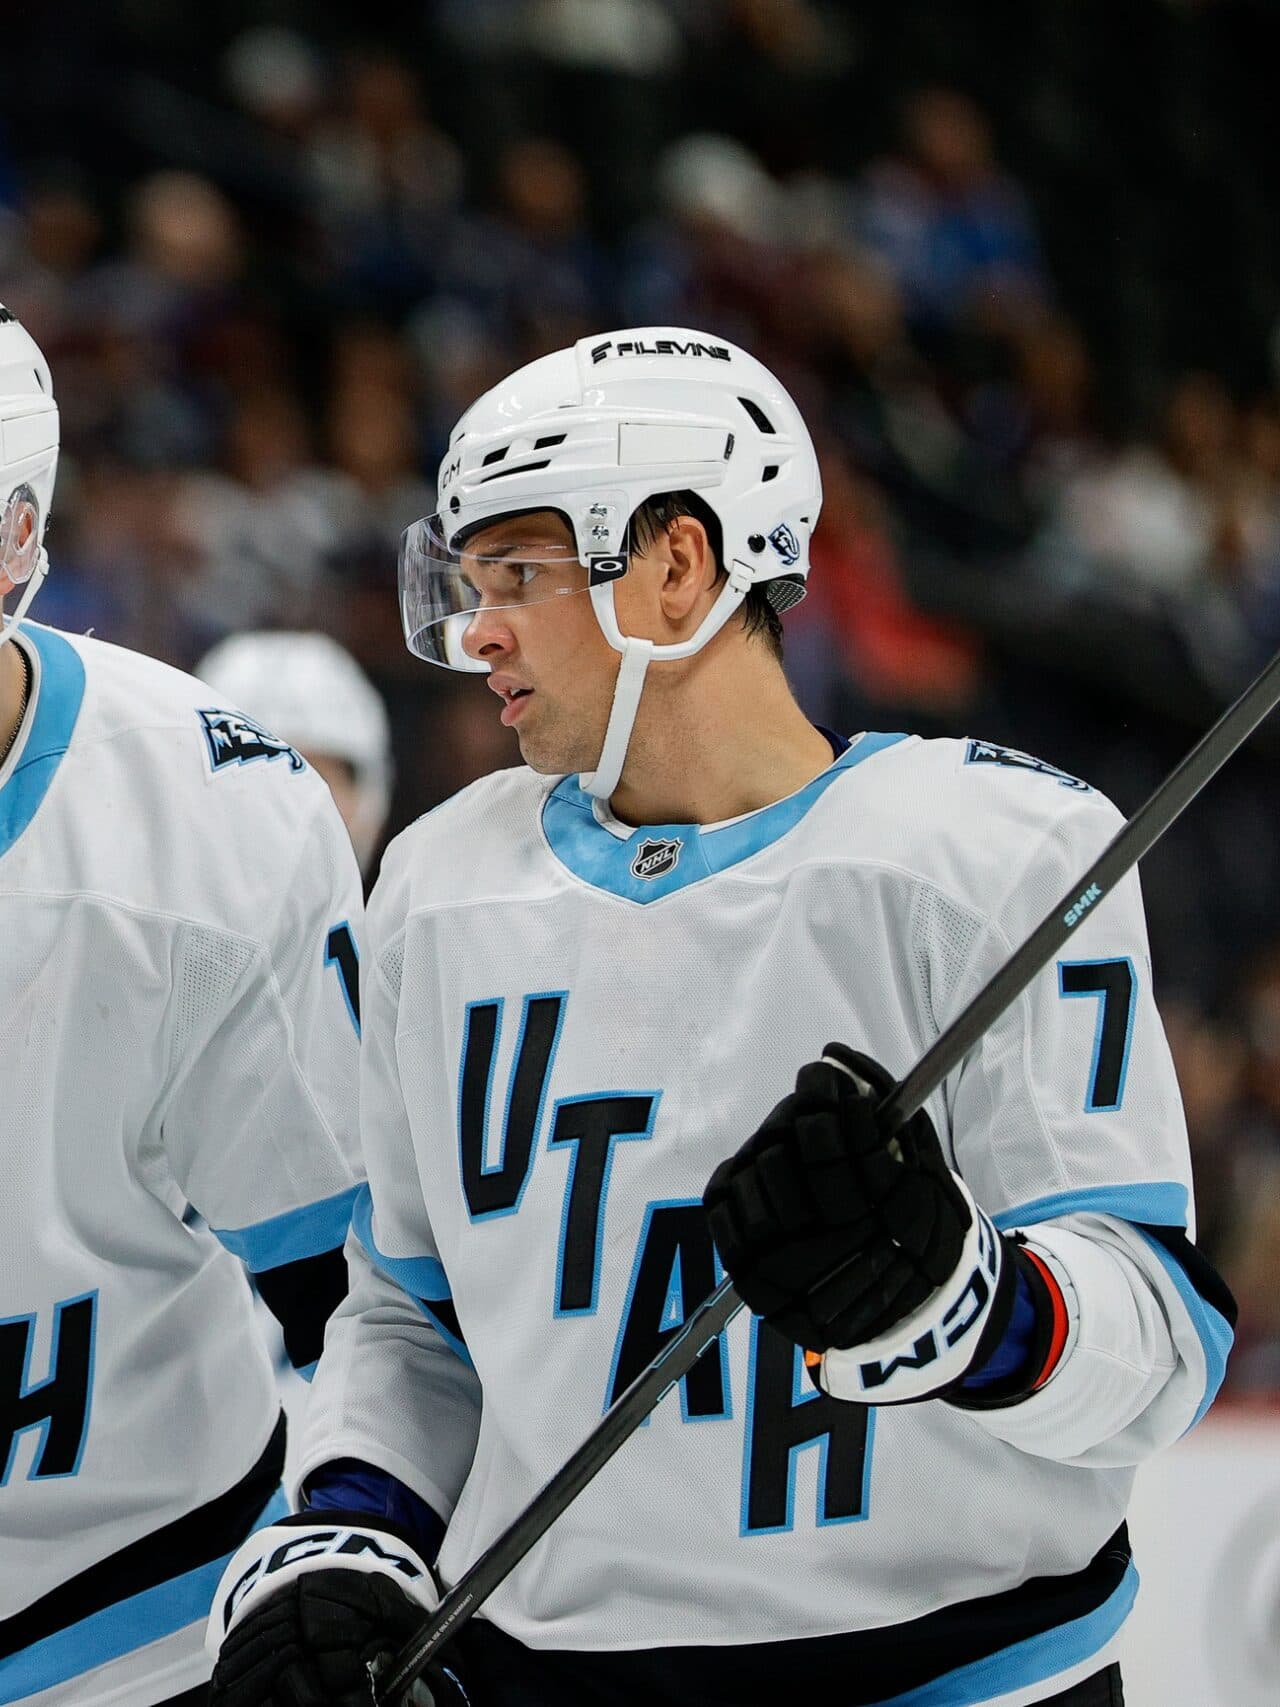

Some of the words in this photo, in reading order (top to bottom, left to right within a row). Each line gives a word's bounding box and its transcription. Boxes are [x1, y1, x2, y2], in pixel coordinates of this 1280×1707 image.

[617, 341, 731, 362] FILEVINE
[442, 457, 461, 489] CM
[640, 849, 672, 872] NHL
[1063, 882, 1103, 927] SMK
[1057, 957, 1138, 1113] 7
[458, 991, 877, 1537] UTAH
[858, 1205, 996, 1391] CCM
[224, 1531, 422, 1634] CCM
